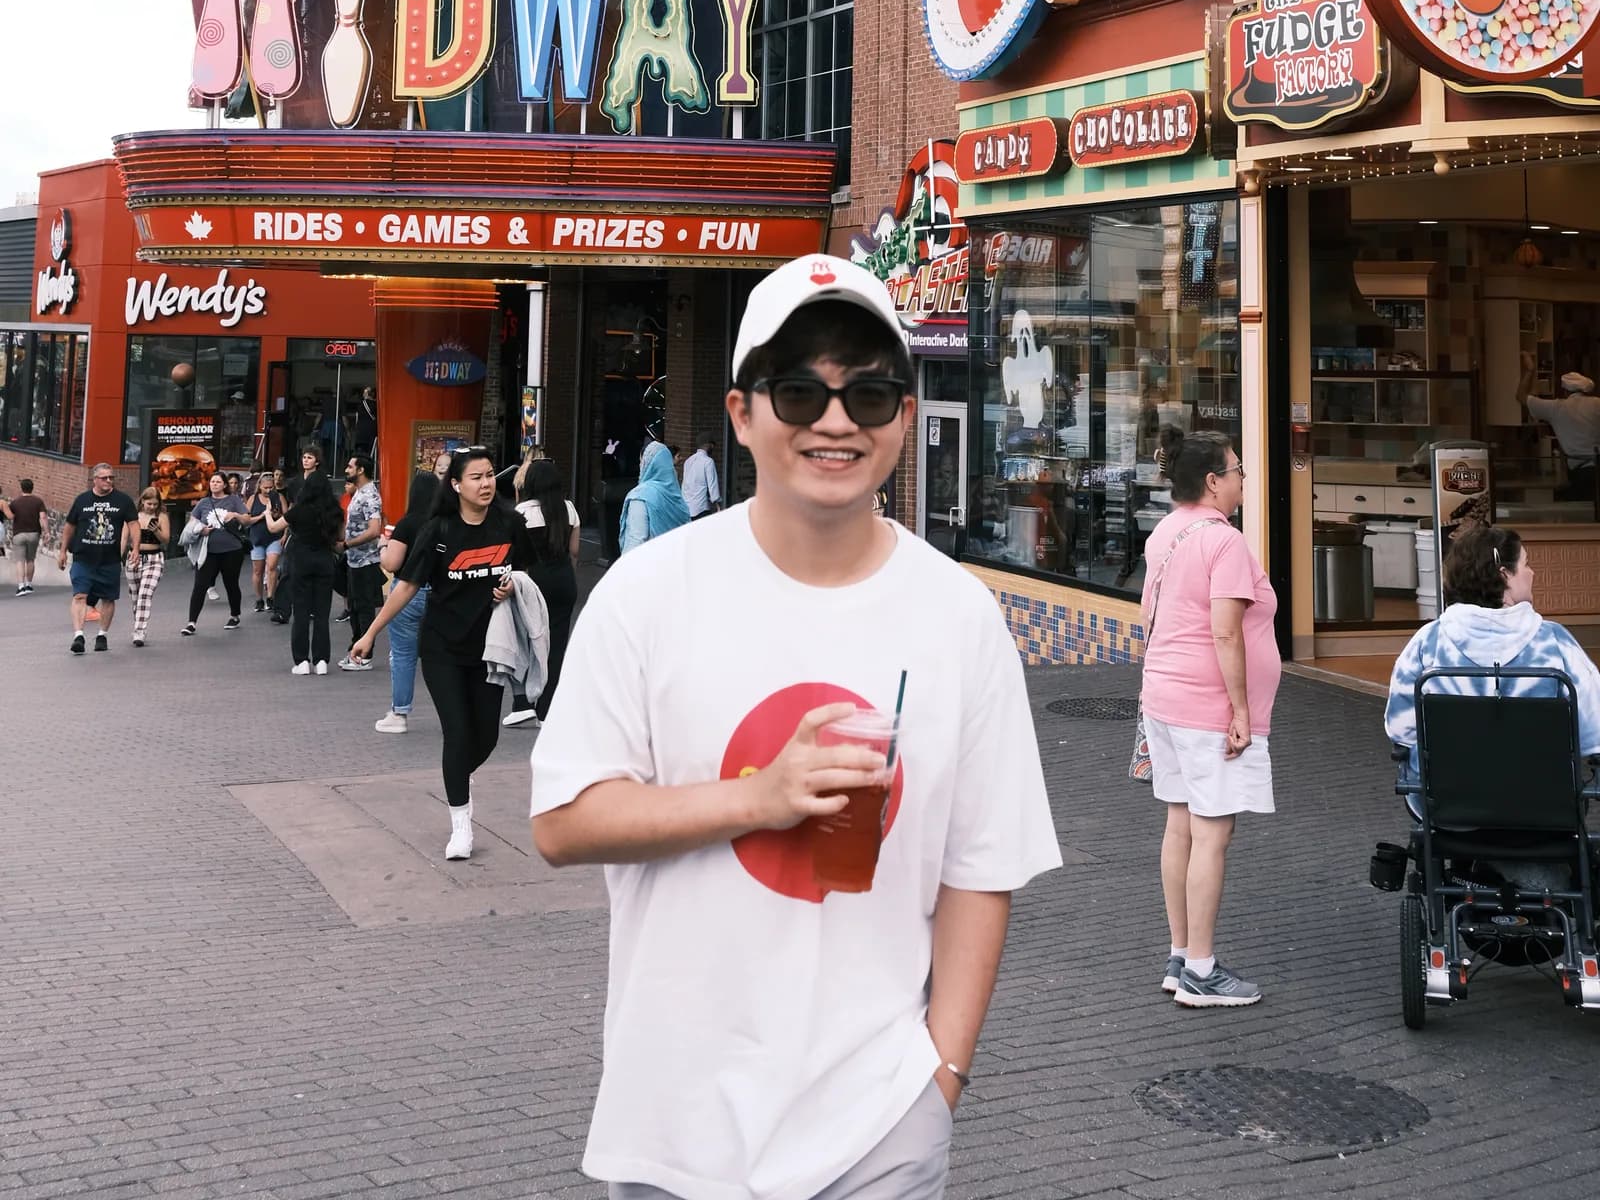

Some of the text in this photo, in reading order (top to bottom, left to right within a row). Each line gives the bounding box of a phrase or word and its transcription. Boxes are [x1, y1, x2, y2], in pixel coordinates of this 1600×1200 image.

[1275, 50, 1353, 104] FACTORY
[1074, 105, 1190, 153] CHOCOLATE
[974, 133, 1032, 171] CANDY
[254, 211, 761, 250] RIDES GAMES & PRIZES FUN
[125, 268, 266, 327] Wendy's
[325, 343, 357, 356] OPEN
[909, 333, 949, 347] Interactive
[157, 416, 214, 425] BEHOLD THE
[157, 425, 214, 435] BACONATOR
[448, 564, 512, 580] ON THE EDG
